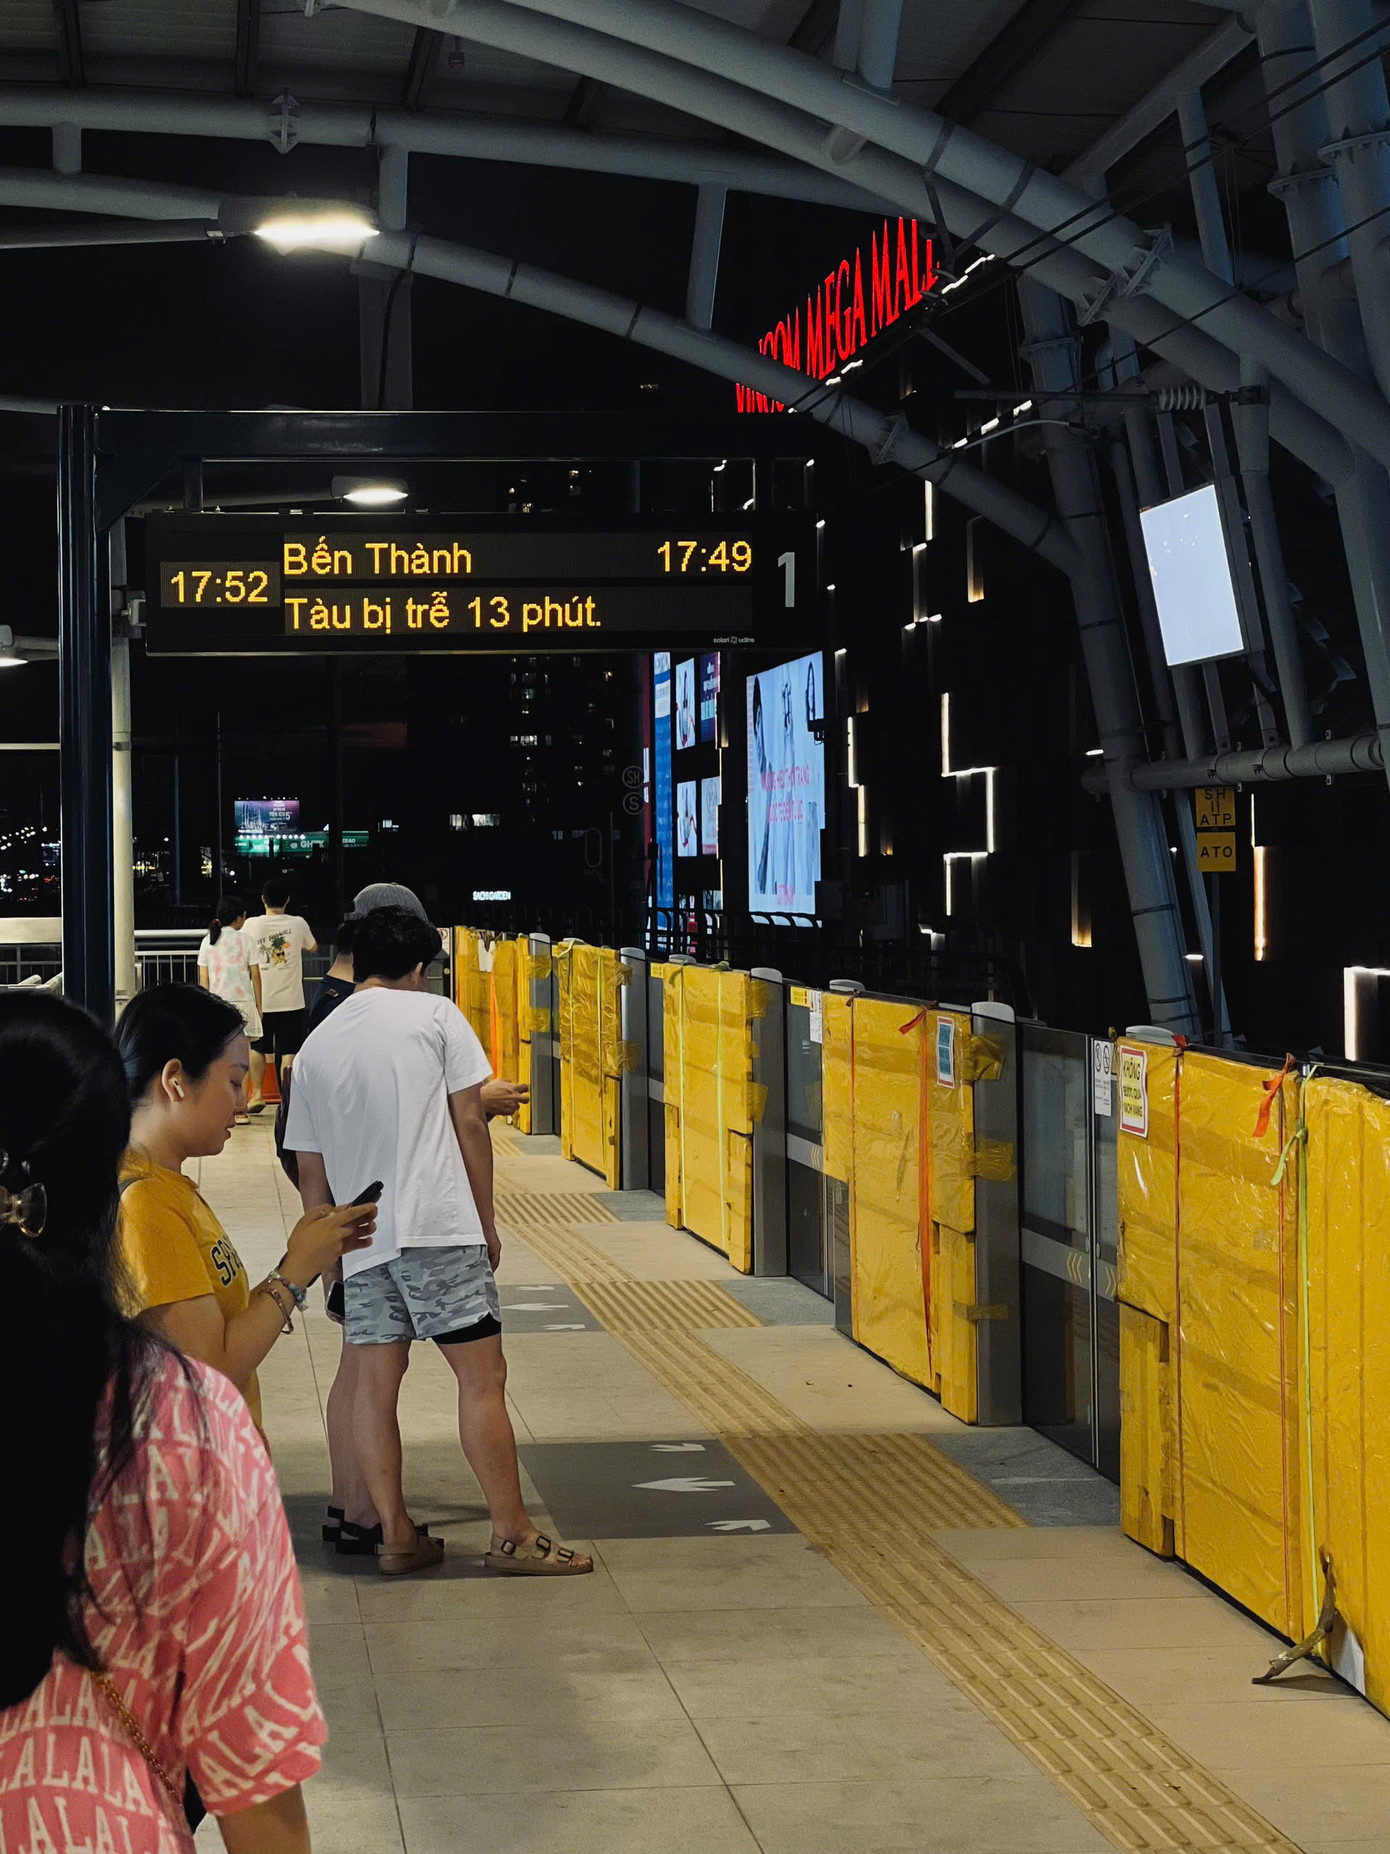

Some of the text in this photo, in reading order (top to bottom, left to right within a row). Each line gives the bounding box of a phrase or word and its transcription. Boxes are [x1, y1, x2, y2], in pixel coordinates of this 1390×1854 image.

[806, 247, 868, 380] MEGA
[871, 216, 939, 337] MALL
[284, 536, 752, 574] Bến Thành 17:49
[170, 571, 268, 602] 17:52
[777, 552, 796, 607] 1
[285, 592, 602, 633] Tàu bị trễ 13 phút.
[627, 770, 640, 785] SH
[1205, 788, 1226, 800] SH
[1200, 813, 1232, 825] ATP
[1200, 846, 1233, 858] ATO
[211, 1236, 245, 1286] SP
